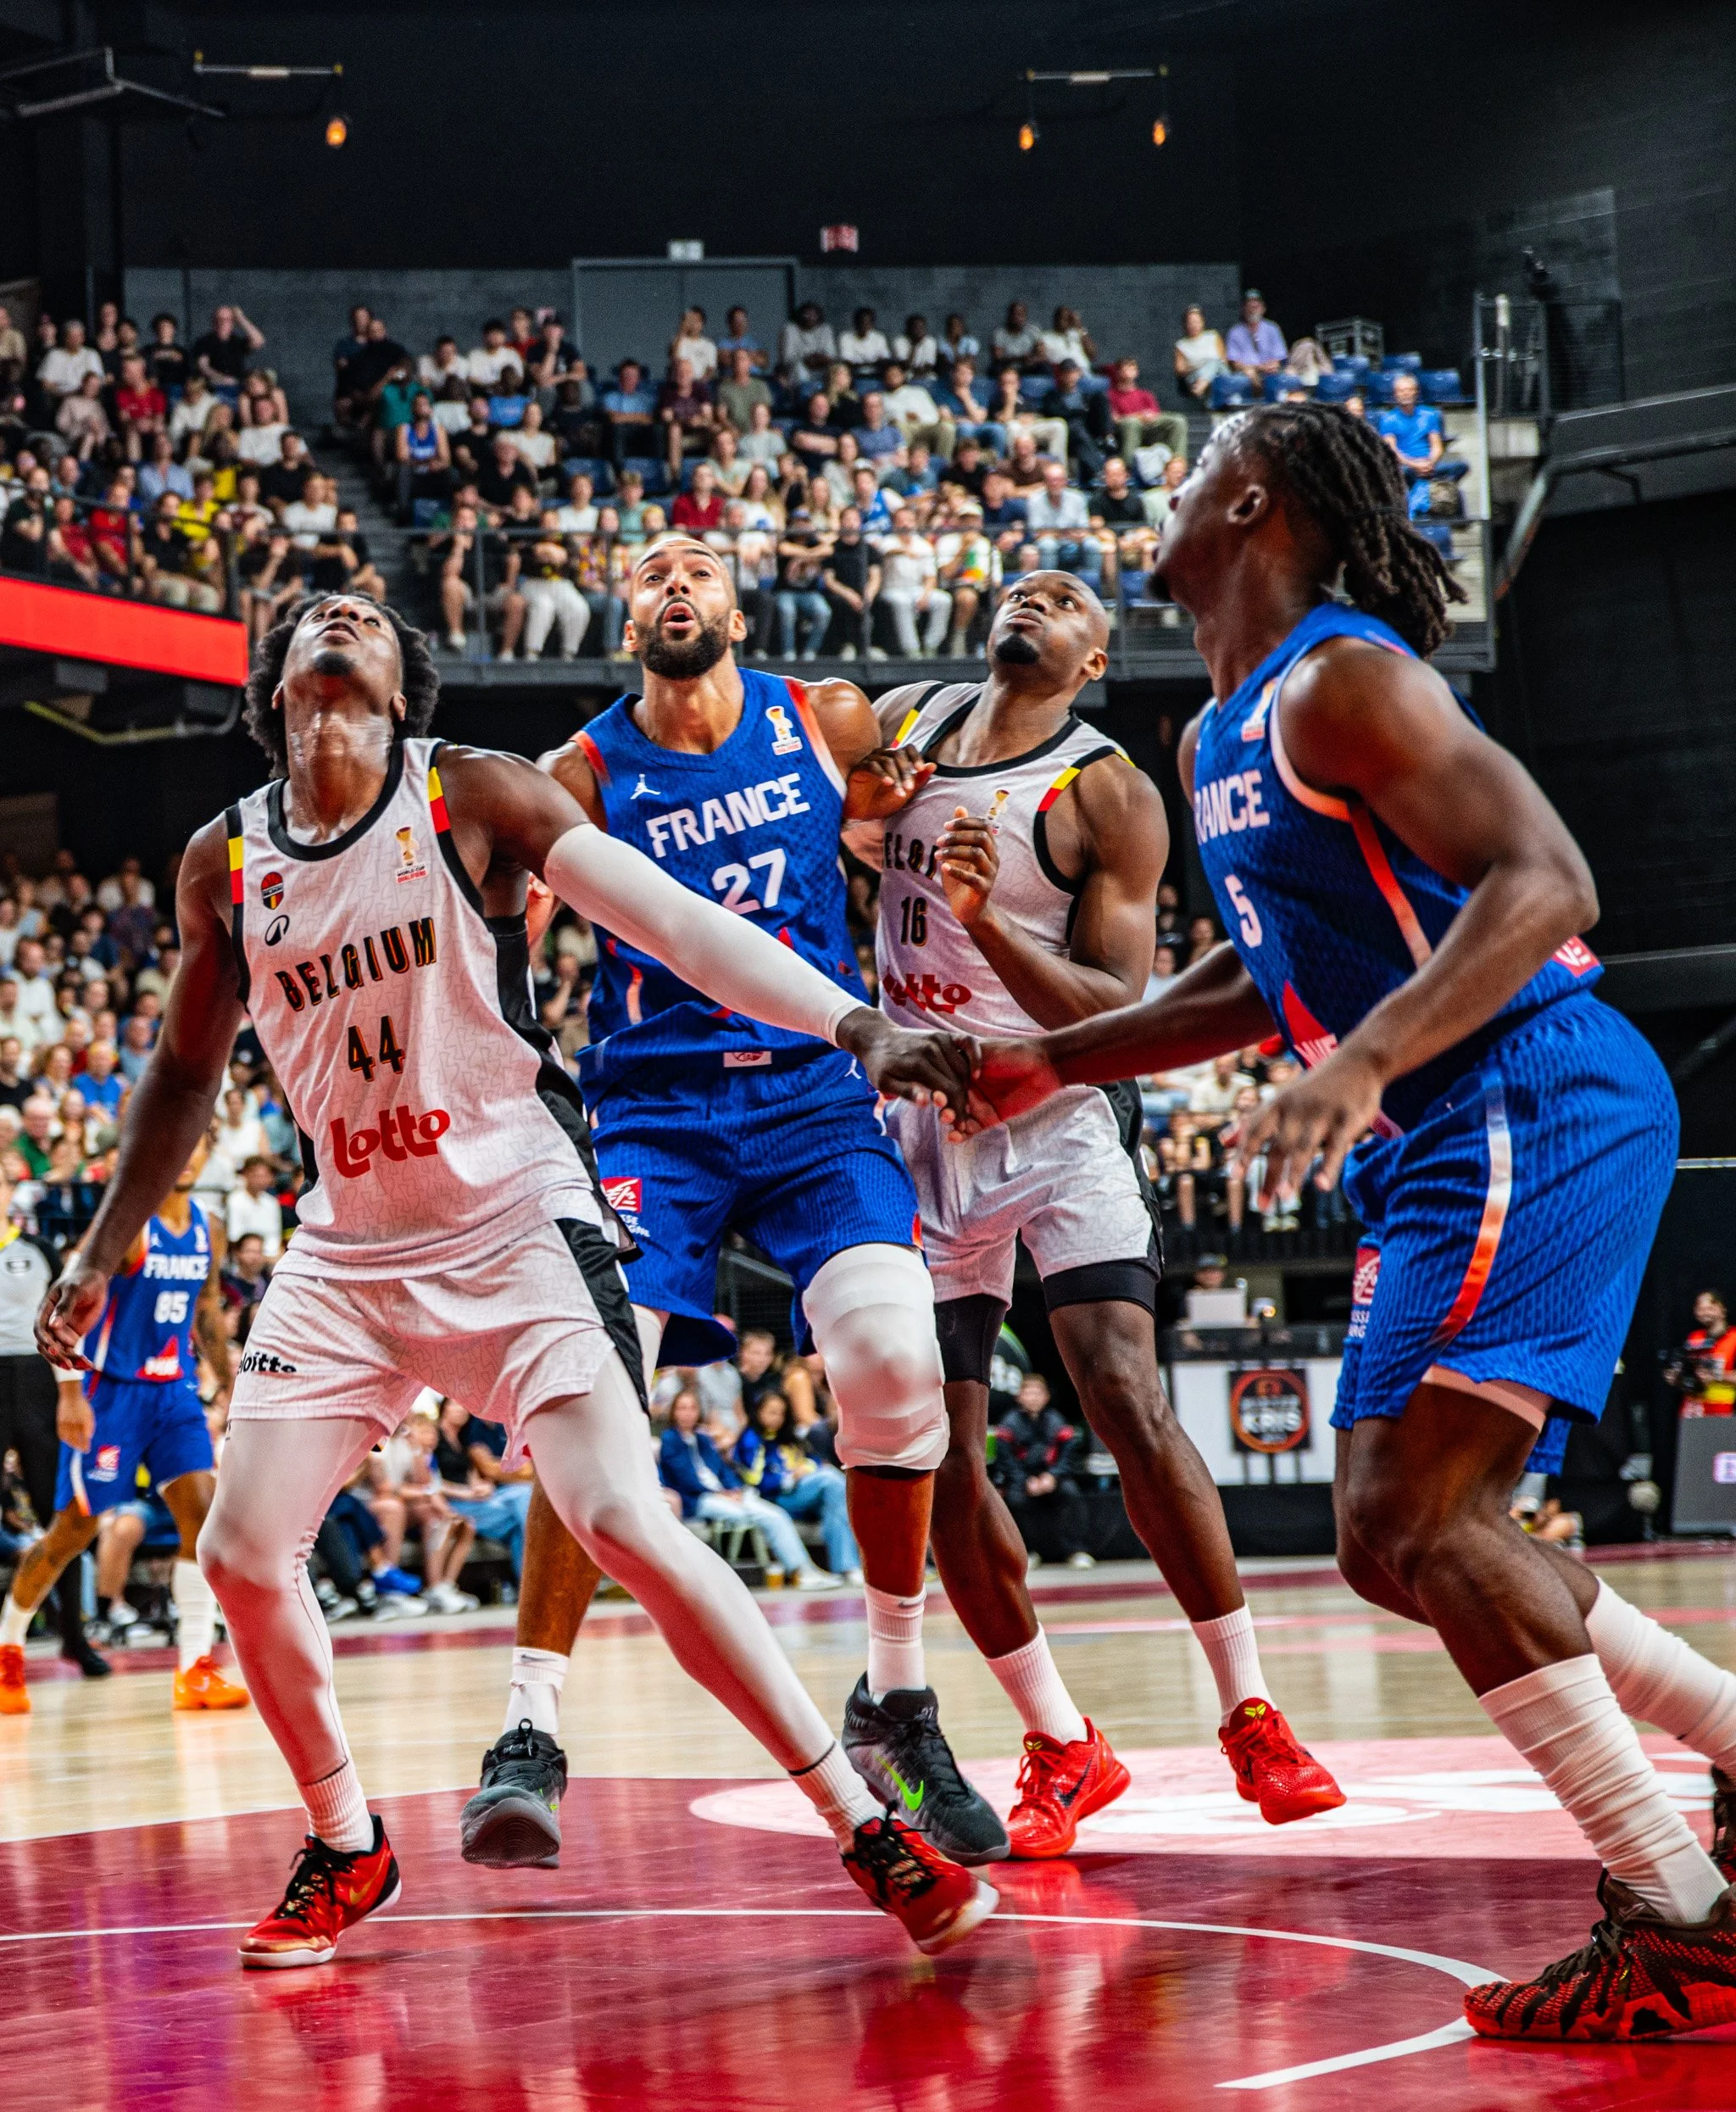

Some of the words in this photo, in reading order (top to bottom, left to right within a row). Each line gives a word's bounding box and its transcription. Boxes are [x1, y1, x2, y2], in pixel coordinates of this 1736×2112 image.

[645, 772, 811, 858] FRANCE
[1194, 768, 1271, 846] RANCE
[711, 848, 787, 916] 27
[1224, 873, 1263, 949] 5
[900, 895, 928, 948] 16
[275, 917, 437, 1012] BELGIUM
[348, 1015, 406, 1083] 44
[142, 1252, 209, 1281] FRANCE
